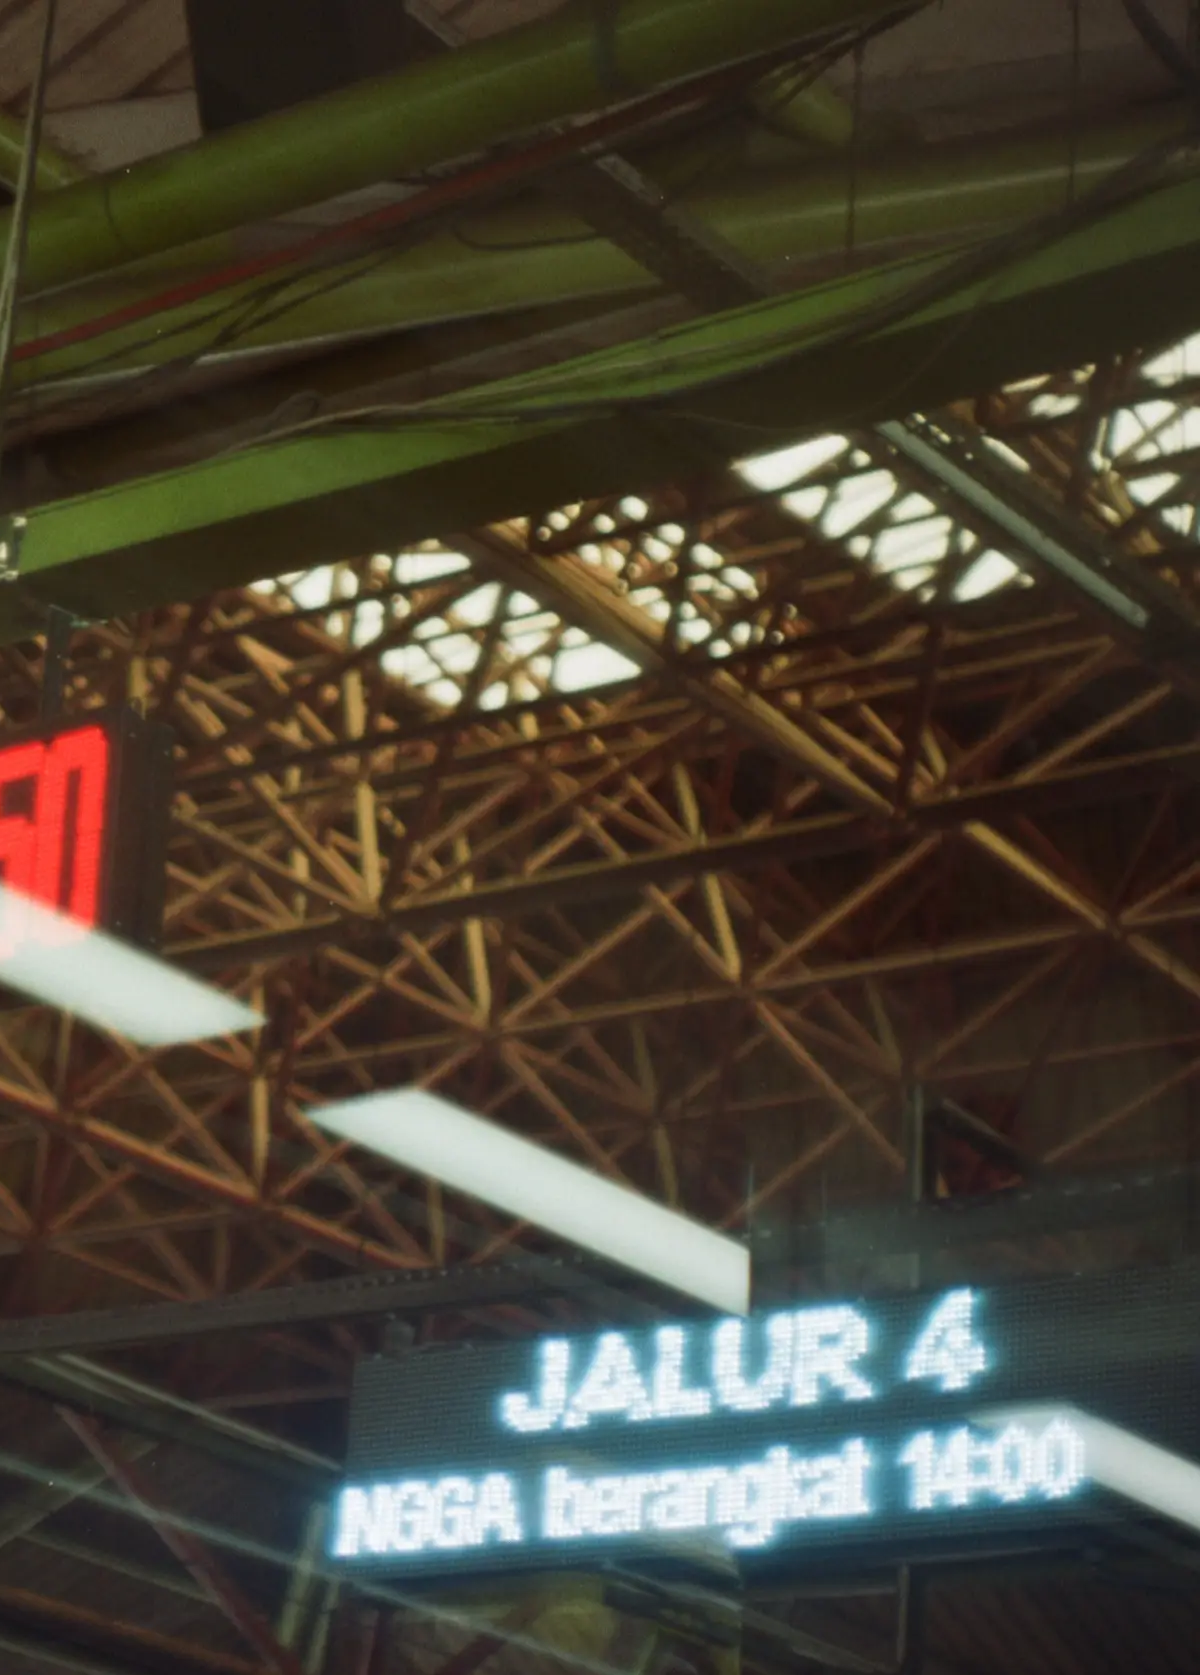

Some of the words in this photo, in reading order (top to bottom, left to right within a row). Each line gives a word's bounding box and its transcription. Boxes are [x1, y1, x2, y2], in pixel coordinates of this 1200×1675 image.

[499, 1305, 874, 1433] JALUR
[904, 1287, 987, 1391] 4
[542, 1436, 873, 1548] berangkat
[898, 1416, 1086, 1509] 14:00
